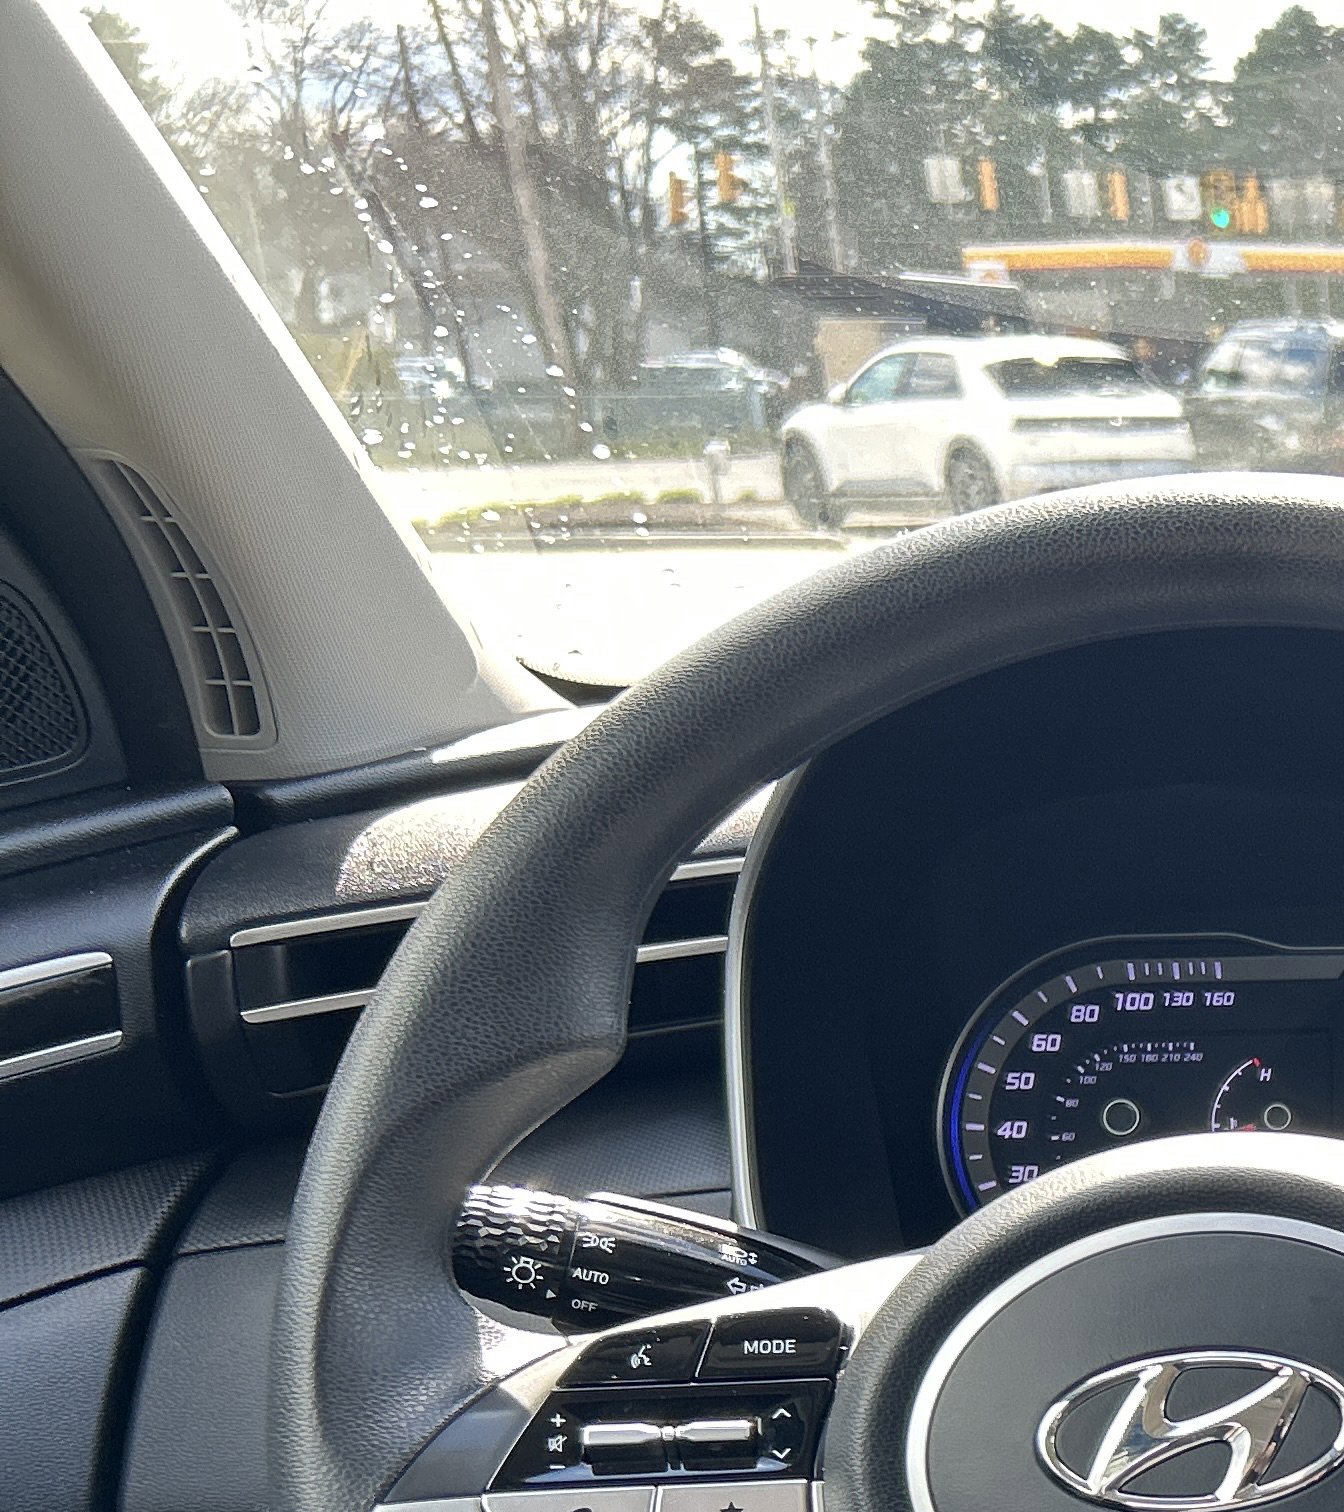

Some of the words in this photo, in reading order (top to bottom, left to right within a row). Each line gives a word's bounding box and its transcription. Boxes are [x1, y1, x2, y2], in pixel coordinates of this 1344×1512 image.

[1114, 991, 1155, 1011] 100
[1162, 991, 1194, 1007] 130
[1204, 991, 1235, 1007] 160
[1070, 1004, 1100, 1023] 80
[1031, 1033, 1062, 1052] 60
[1117, 1053, 1137, 1064] 150
[1160, 1053, 1181, 1063] 210
[1183, 1052, 1203, 1062] 240
[1094, 1061, 1113, 1073] 120
[1259, 1067, 1272, 1082] H
[1005, 1071, 1036, 1091] 50
[1079, 1074, 1098, 1085] 100
[997, 1120, 1028, 1140] 40
[1008, 1165, 1039, 1184] 30
[571, 1267, 610, 1285] AUTO
[571, 1298, 599, 1313] OFF
[743, 1339, 797, 1355] MODE
